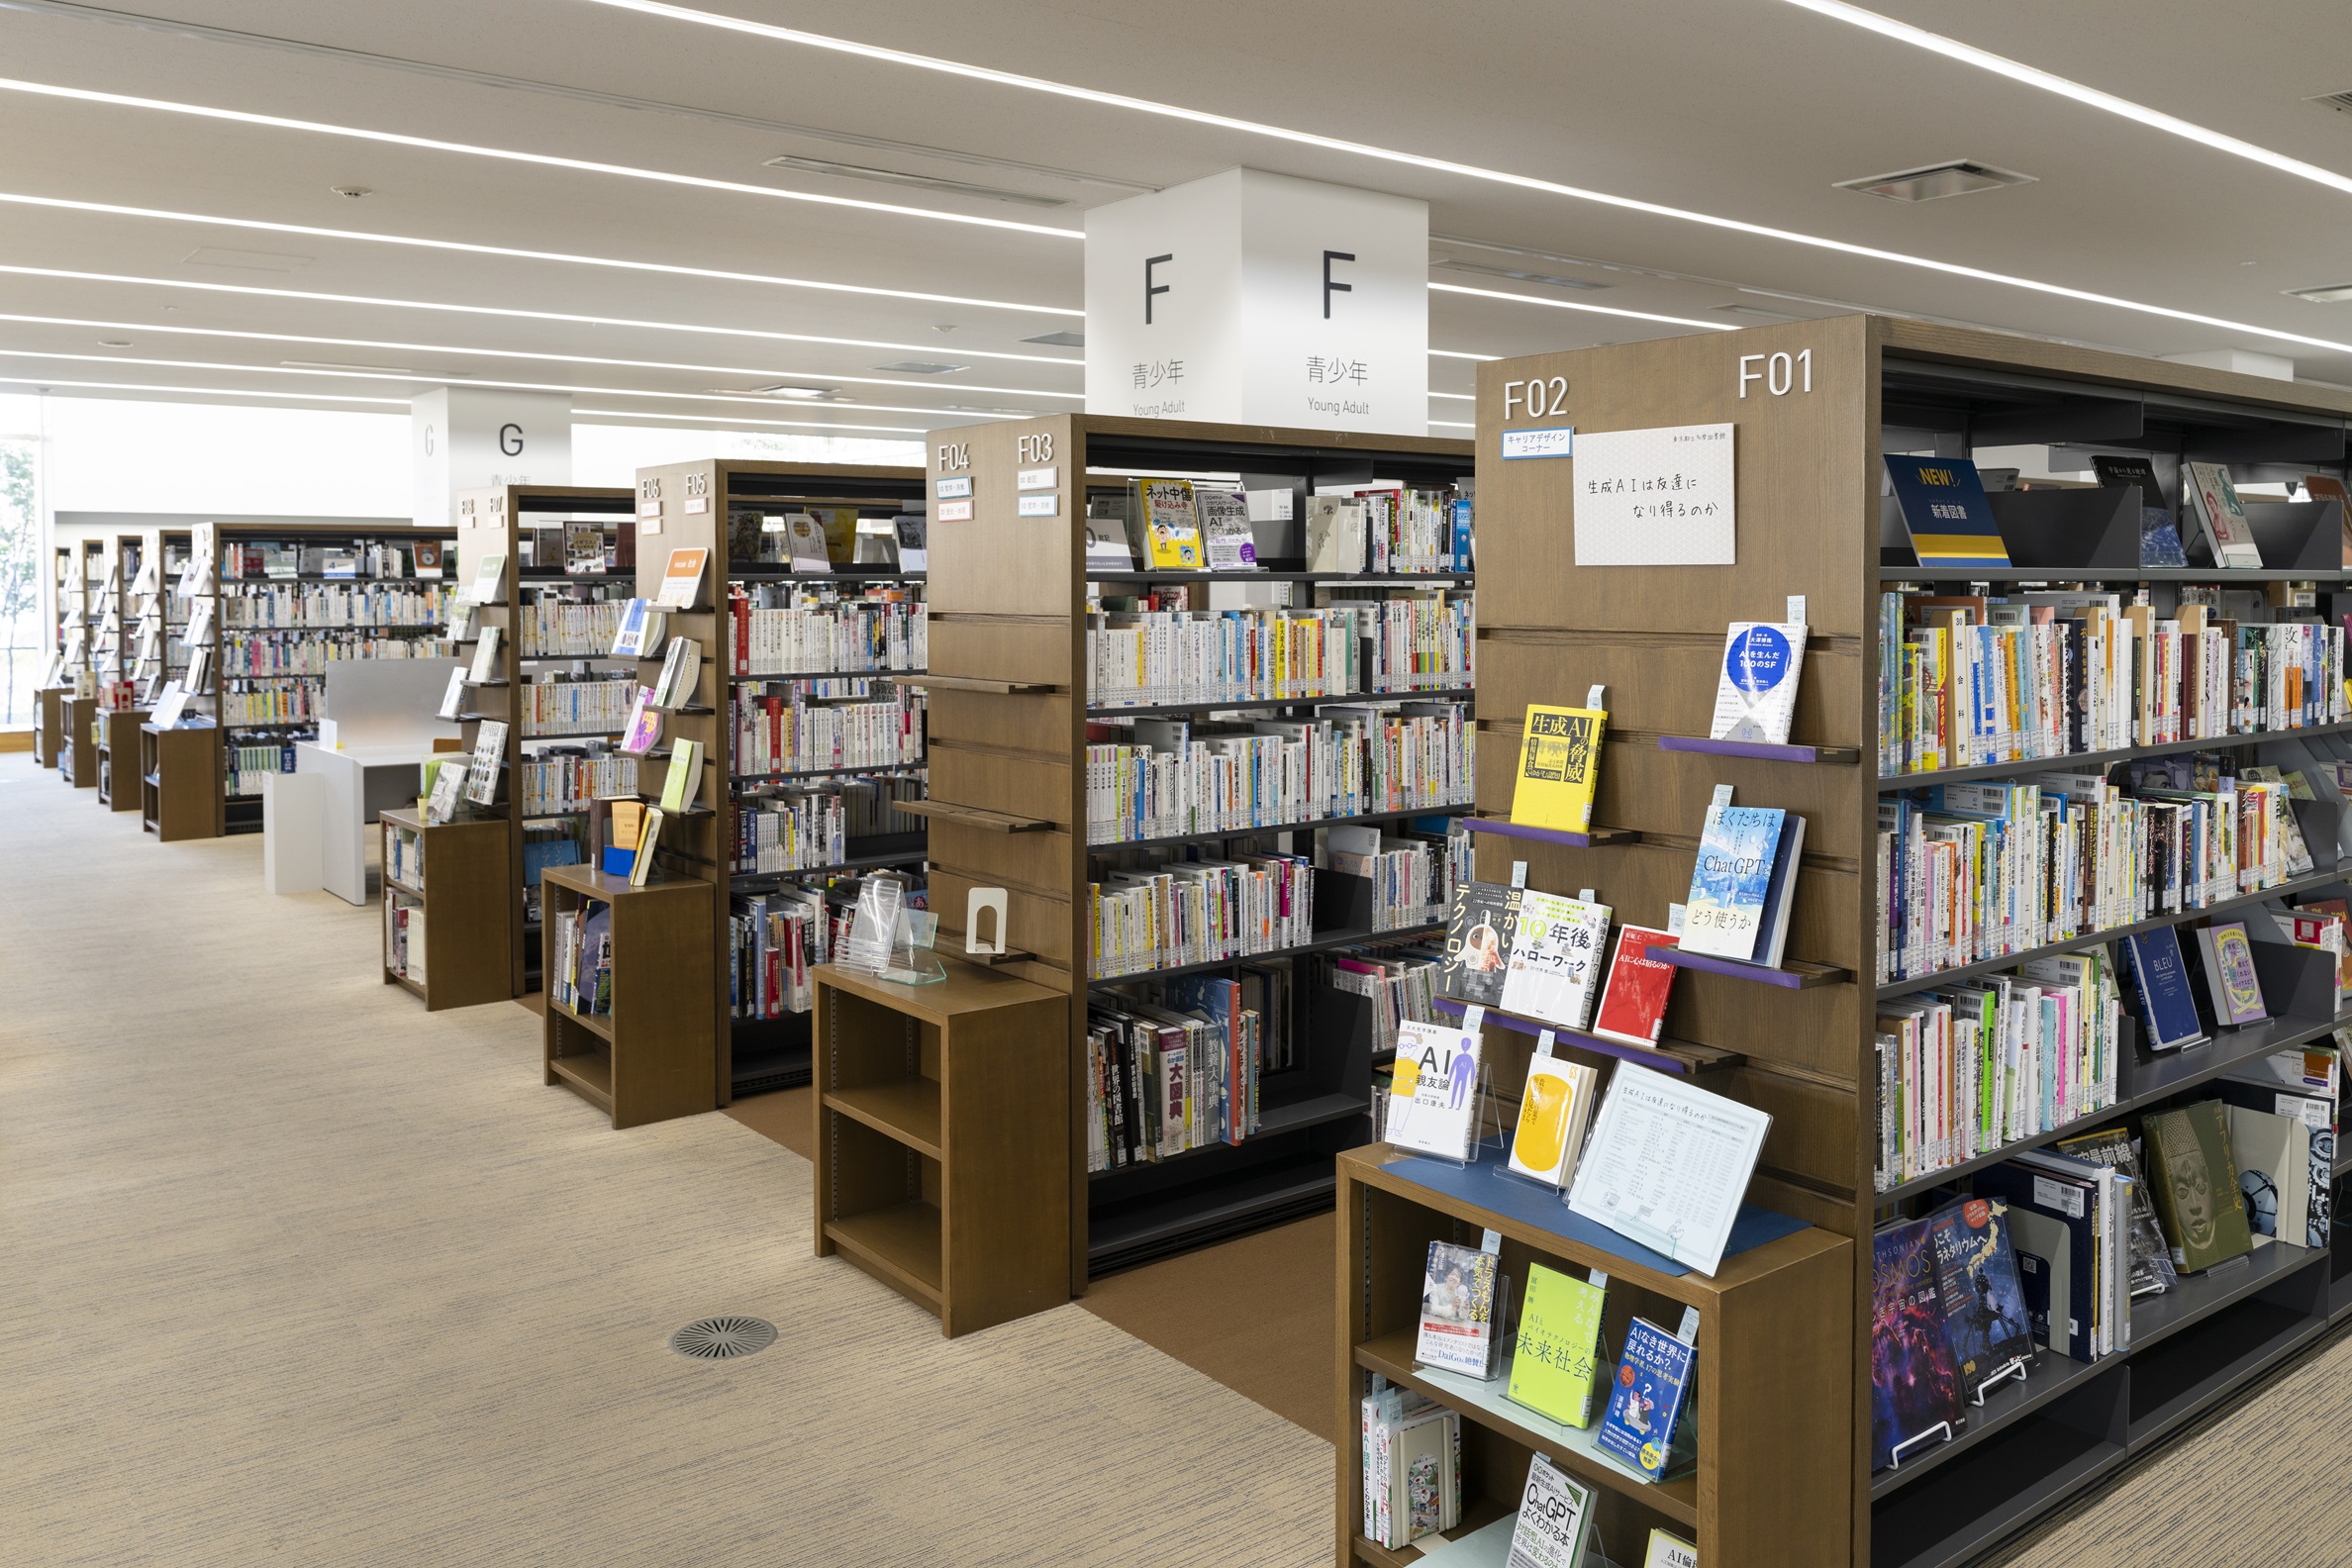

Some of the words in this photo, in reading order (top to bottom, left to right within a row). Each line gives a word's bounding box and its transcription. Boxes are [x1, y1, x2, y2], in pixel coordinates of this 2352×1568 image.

[1146, 253, 1172, 325] F
[1323, 249, 1355, 319] F
[1132, 359, 1183, 389] 青少年
[1307, 355, 1368, 386] 青少年
[1739, 348, 1813, 398] F01
[1133, 401, 1160, 418] Young
[1162, 400, 1185, 414] Adult
[1308, 397, 1340, 416] Young
[1342, 401, 1370, 415] Adult
[1504, 376, 1569, 420] F02
[426, 425, 434, 456] G
[499, 423, 524, 456] G
[1018, 434, 1052, 463] F03
[1508, 433, 1566, 444] キャリアデザイン
[938, 443, 970, 471] F04
[490, 474, 531, 486] 青少年
[642, 479, 660, 498] F06
[686, 473, 706, 494] F05
[1146, 484, 1192, 501] ネット中傷
[1919, 468, 1956, 487] NEW!
[1207, 506, 1245, 517] 画像生成
[1632, 501, 1718, 518] なり得るのか
[1931, 504, 1967, 520] 新着図書
[1532, 715, 1592, 738] 生成AI
[1713, 810, 1776, 828] ぼくたちは
[1502, 890, 1521, 948] 温かい
[1692, 909, 1751, 931] どう使うか
[1444, 884, 1470, 992] テクノロジー
[1514, 948, 1587, 972] ハローワーク
[1618, 954, 1671, 969] AIに心は宿るのか
[2153, 956, 2173, 972] BLEU
[1208, 1038, 1220, 1109] 教養大事典
[1419, 1046, 1451, 1075] AI
[1111, 1065, 1124, 1126] 世界の図書館
[1416, 1074, 1450, 1091] 親友論
[2216, 1115, 2243, 1211] アフリカ全史
[1469, 1256, 1485, 1321] 本気でつくる
[1480, 1256, 1496, 1323] ドラえもんを
[1573, 1287, 1587, 1325] 考える
[1584, 1291, 1600, 1344] みんなで
[1527, 1324, 1592, 1355] バイオテクノロジーの
[1629, 1326, 1687, 1363] AIなき世界に
[1517, 1331, 1593, 1382] 未来社会
[1531, 1471, 1574, 1507] 最新生成AIサービス
[1526, 1483, 1576, 1531] ChatGPT
[1521, 1506, 1570, 1547] よくわかる本
[1517, 1521, 1566, 1565] 対話型AIの進化で
